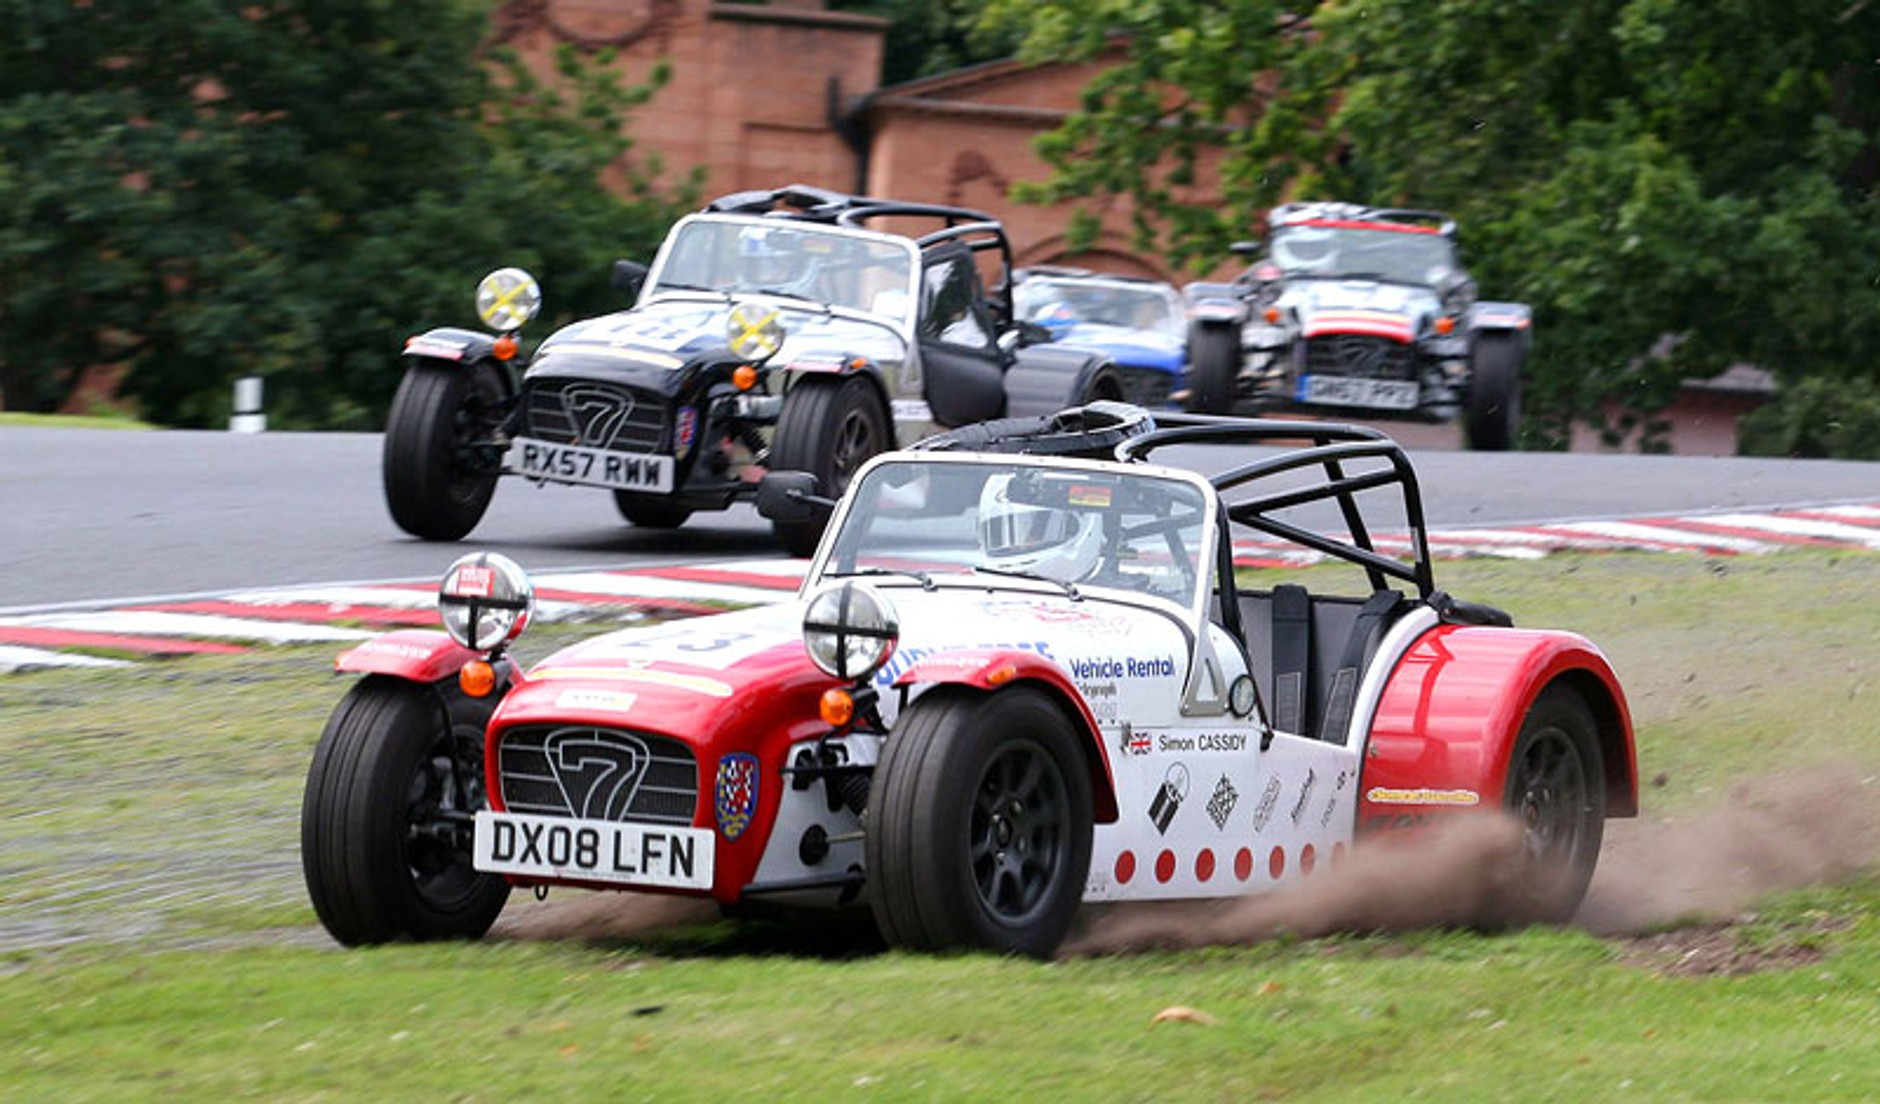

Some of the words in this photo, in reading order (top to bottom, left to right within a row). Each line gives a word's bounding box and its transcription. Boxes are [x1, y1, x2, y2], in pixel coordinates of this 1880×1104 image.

[522, 443, 596, 479] RX57
[603, 454, 661, 486] RWW
[1069, 656, 1124, 679] Vehicle
[1127, 654, 1175, 678] Rental
[1158, 735, 1195, 751] Simon
[1199, 734, 1247, 751] CASSIDY
[558, 738, 637, 821] 7
[491, 819, 600, 869] DX08
[613, 829, 695, 878] LFN
